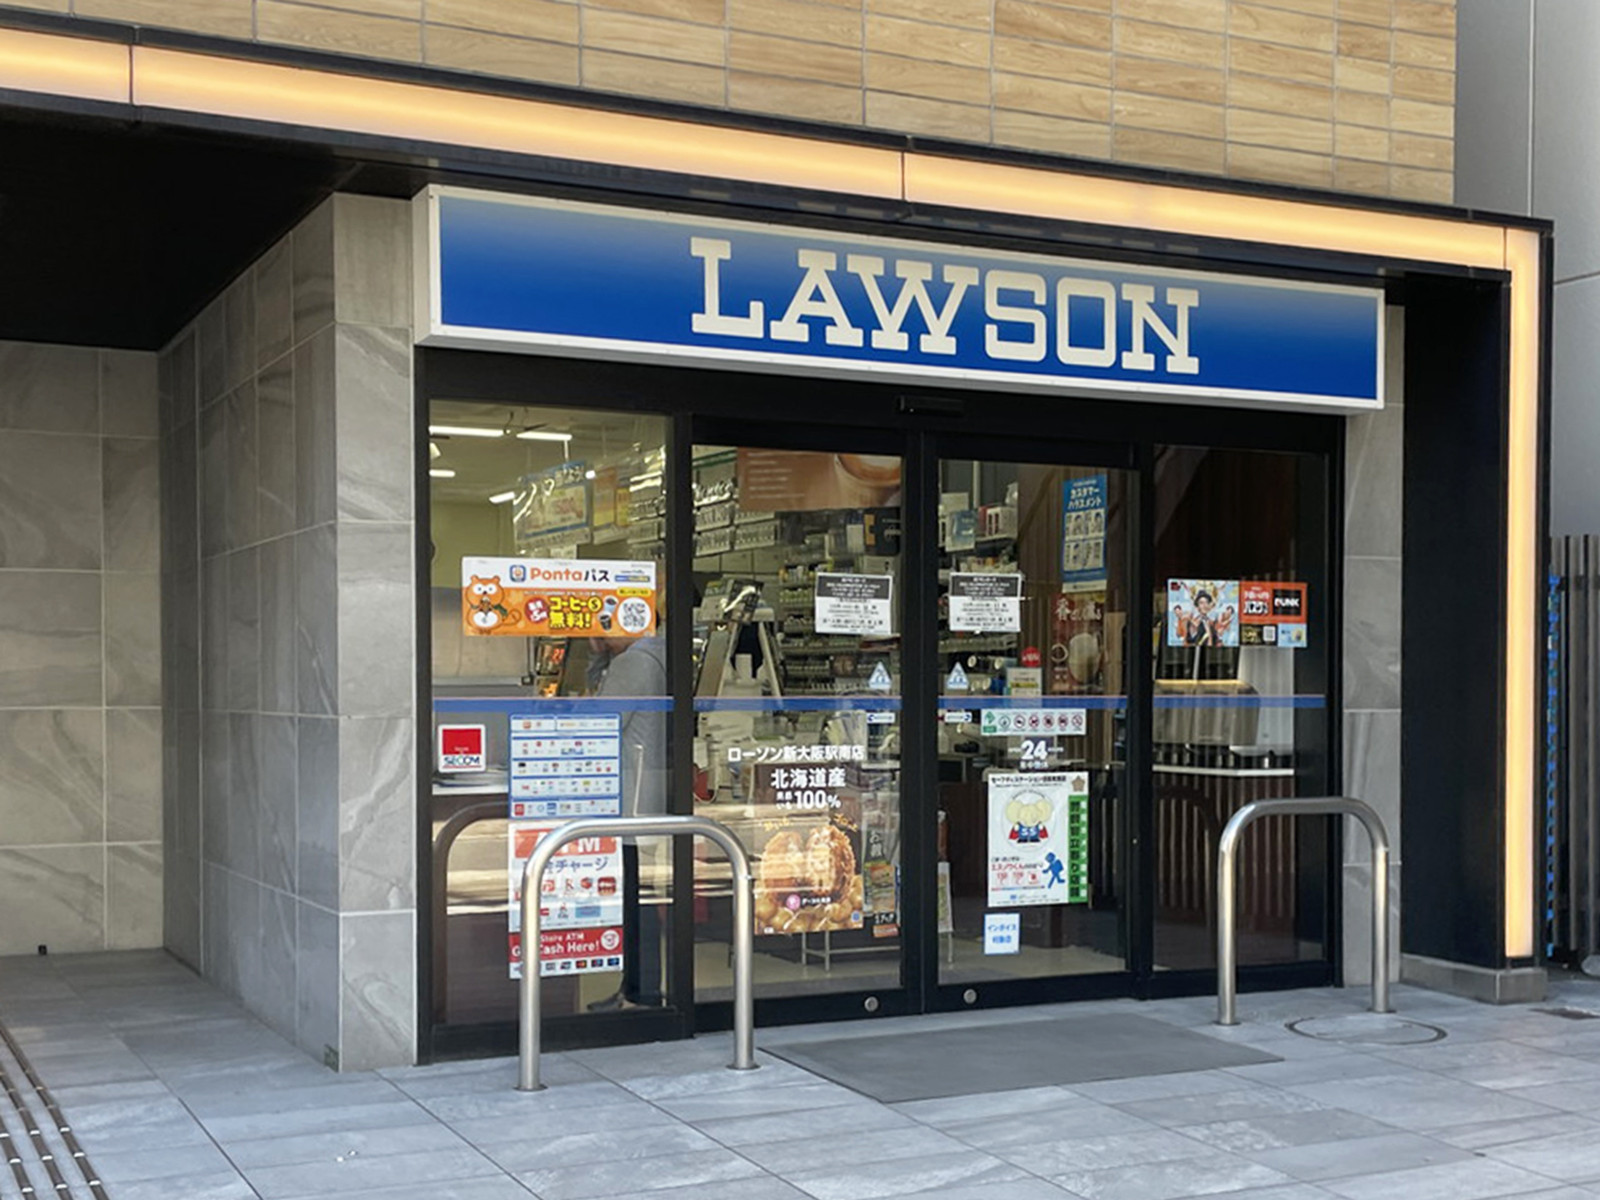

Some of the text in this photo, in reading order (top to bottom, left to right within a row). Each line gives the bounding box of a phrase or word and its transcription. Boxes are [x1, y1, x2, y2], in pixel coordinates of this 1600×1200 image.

[690, 236, 1200, 375] LAWSON
[530, 567, 610, 583] Pontaパス
[727, 745, 865, 762] ローソン新大阪駅南店
[1021, 740, 1048, 760] 24
[444, 755, 480, 766] SECOM
[770, 767, 846, 789] 北海道産
[794, 790, 842, 810] 100%
[565, 932, 585, 941] ATM
[567, 940, 600, 953] Here!
